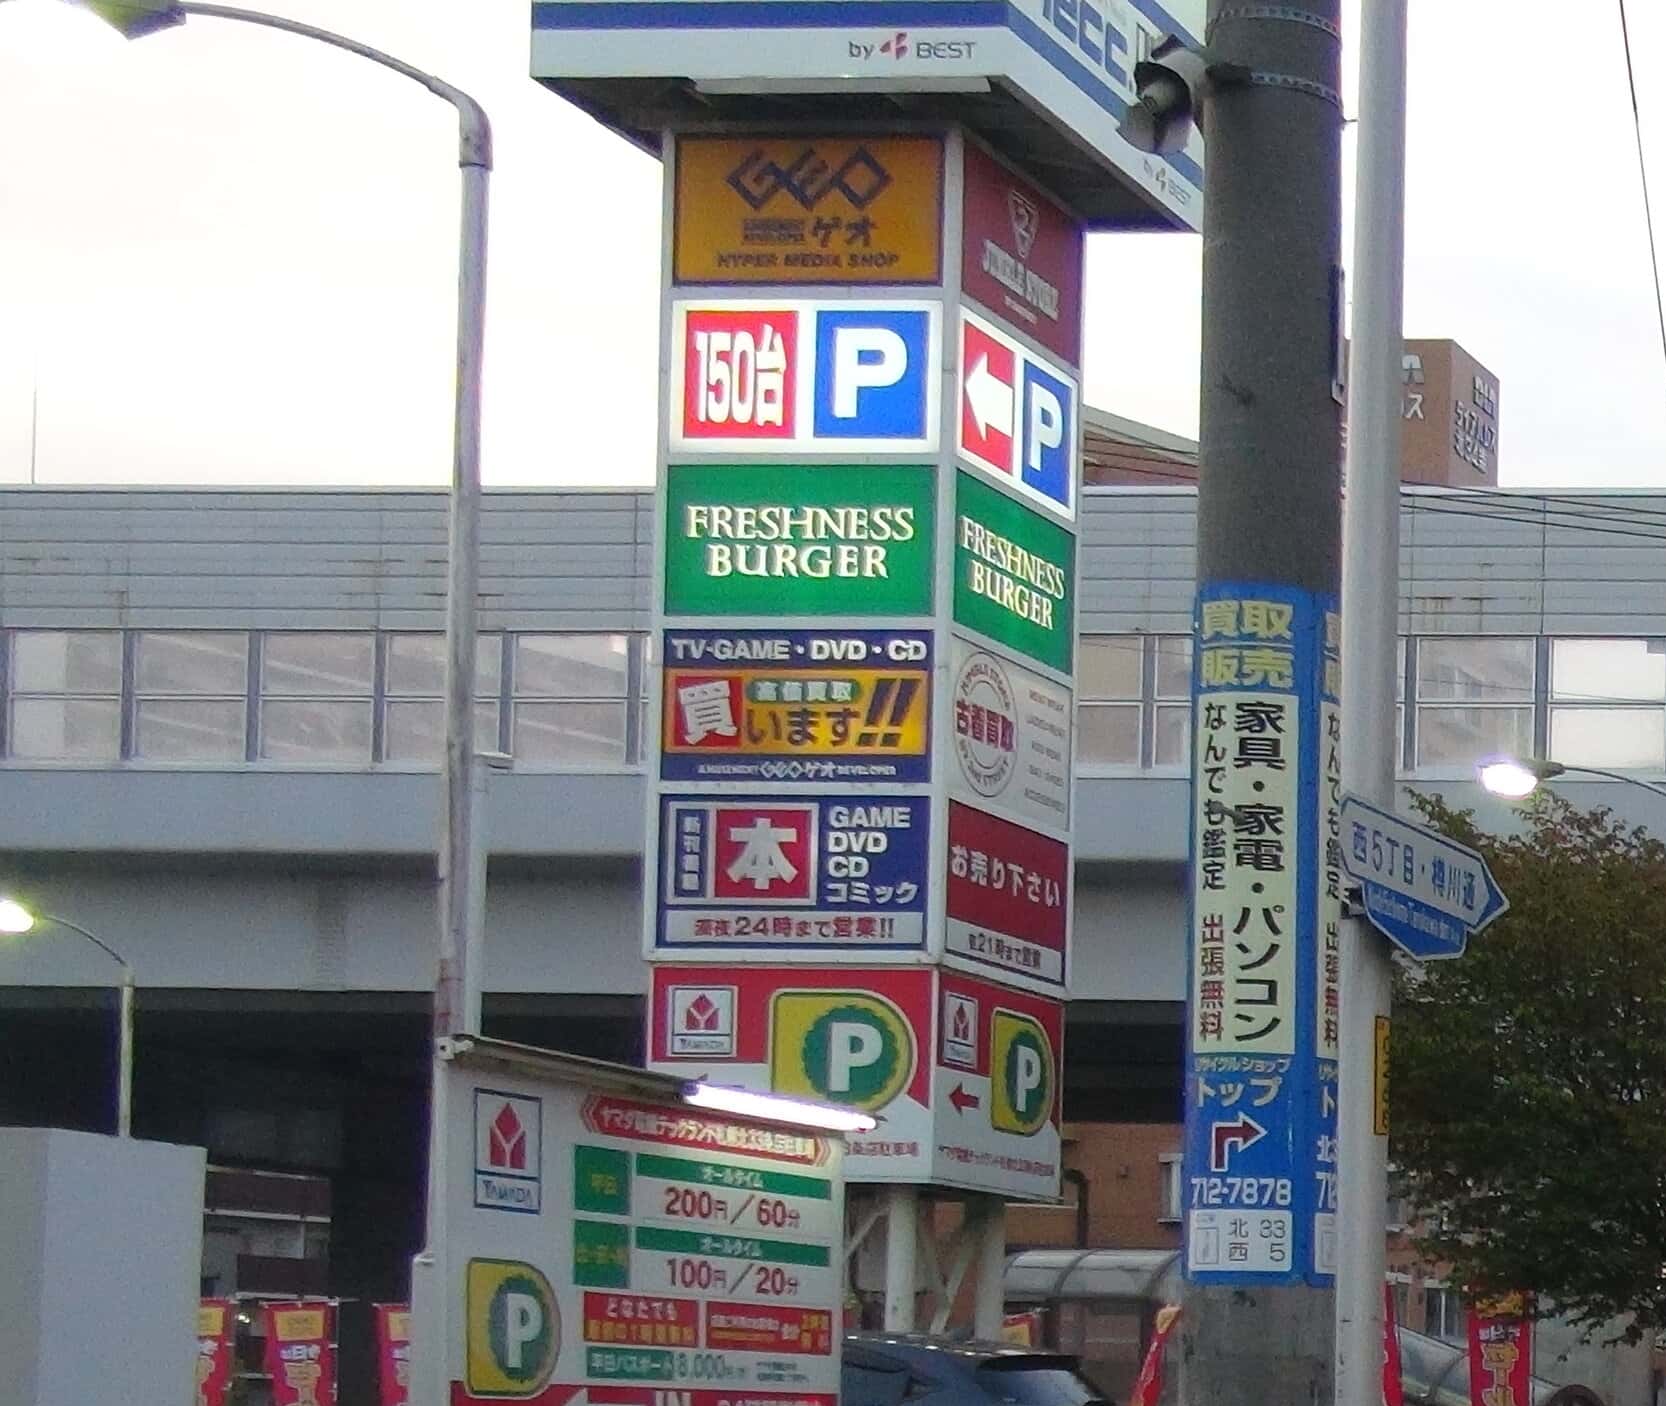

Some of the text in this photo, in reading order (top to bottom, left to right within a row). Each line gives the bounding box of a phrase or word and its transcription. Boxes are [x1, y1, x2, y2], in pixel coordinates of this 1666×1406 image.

[849, 40, 977, 61] by BEST
[726, 146, 894, 211] GEO
[716, 252, 900, 268] HYPER MEDIA SHOP
[695, 324, 787, 428] 150台
[832, 327, 909, 419] P
[1028, 390, 1064, 472] P
[686, 504, 915, 543] FRESHNESS
[706, 545, 890, 580] BURGER
[960, 514, 1066, 602] FRESHNESS
[970, 565, 1055, 632] BURGER
[1202, 601, 1294, 641] 買取
[1200, 649, 1294, 689] 販売
[828, 806, 912, 829] GAME
[727, 817, 799, 890] 本
[828, 831, 888, 853] DVD
[828, 856, 870, 878] CD
[950, 843, 1061, 907] お売り下さい
[826, 881, 918, 904] コミック
[828, 1022, 883, 1092] P
[1016, 1044, 1041, 1112] P
[1198, 1076, 1283, 1108] トップ
[1229, 1219, 1287, 1239] 北 33
[1229, 1242, 1286, 1262] 西 5
[504, 1293, 544, 1369] P
